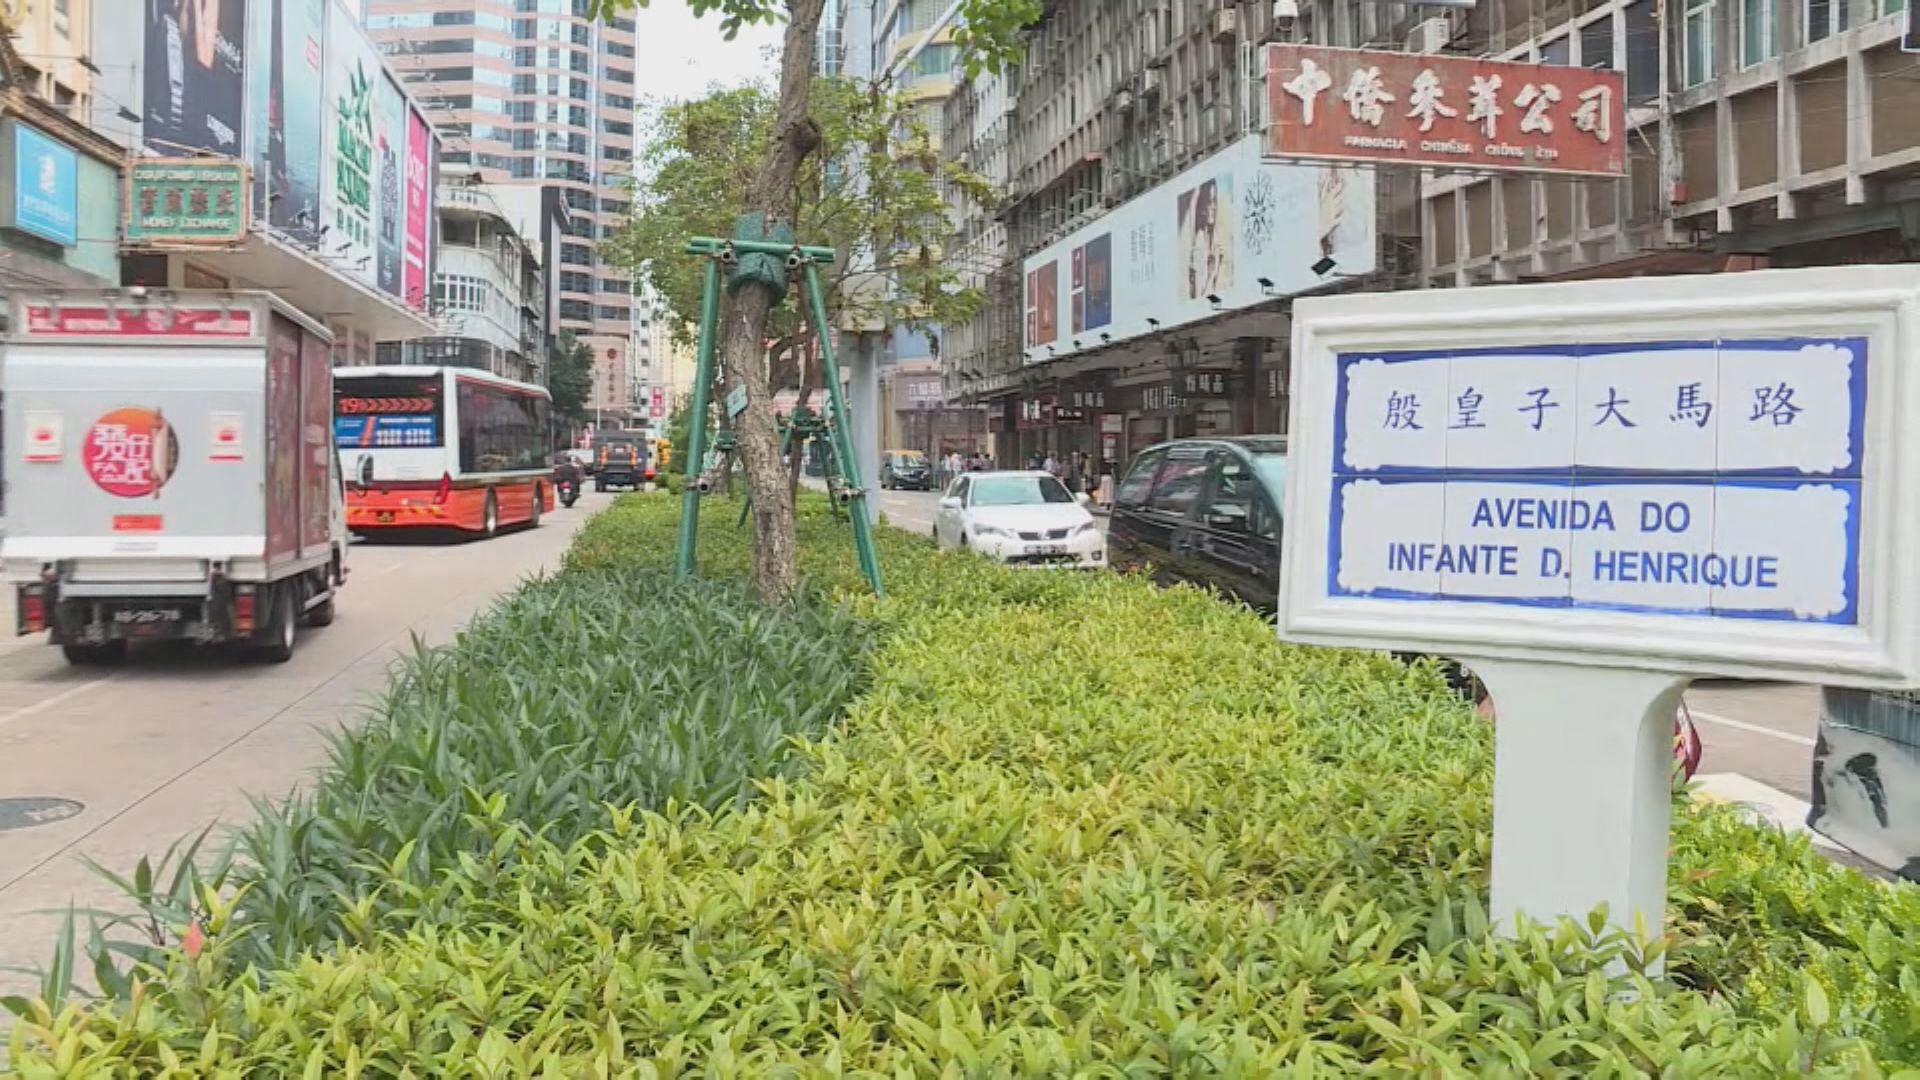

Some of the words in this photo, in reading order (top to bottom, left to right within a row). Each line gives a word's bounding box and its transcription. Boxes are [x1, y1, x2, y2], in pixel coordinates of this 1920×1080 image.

[1283, 58, 1612, 143] 中僑參茸公司
[1344, 136, 1408, 150] FARMACIA
[341, 398, 359, 414] 19
[1382, 381, 1804, 432] 殷皇子大馬路
[1472, 498, 1616, 531] AVENIDA
[1640, 501, 1691, 532] DO
[1387, 542, 1518, 575] INFANTE
[1540, 548, 1571, 579] D.
[1594, 550, 1779, 588] HENRIQUE
